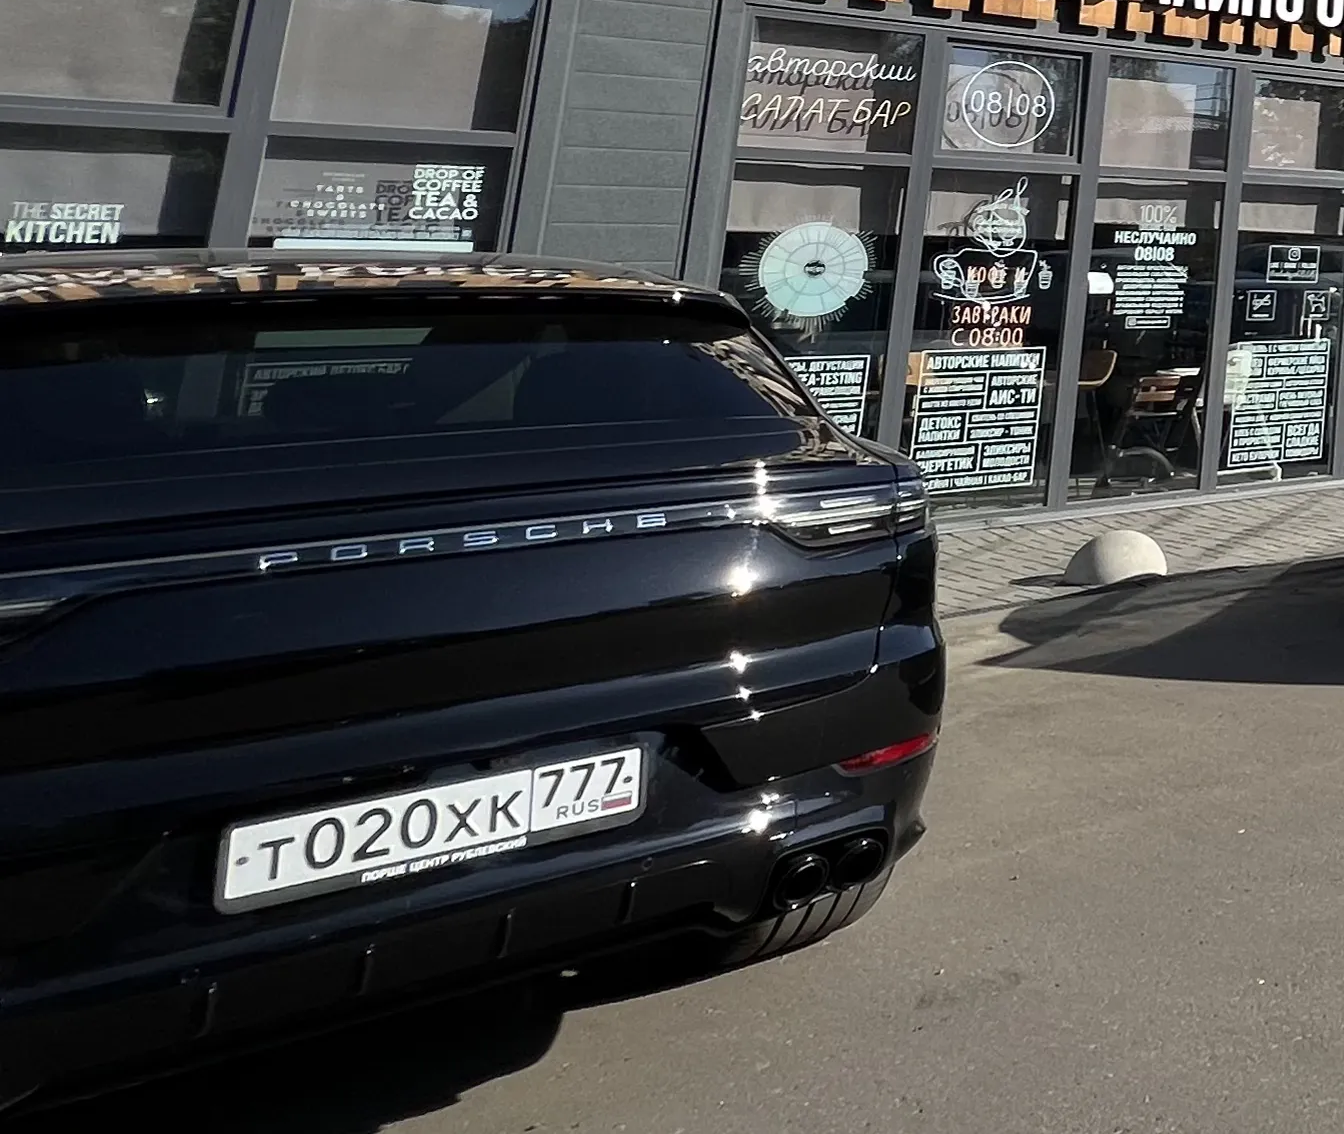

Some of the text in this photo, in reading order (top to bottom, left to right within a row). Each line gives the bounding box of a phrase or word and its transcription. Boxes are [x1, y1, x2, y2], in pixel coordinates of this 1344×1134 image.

[740, 91, 913, 129] САЛАТ БАР
[414, 168, 485, 181] DROP OF
[411, 178, 484, 193] COFFEE
[411, 190, 479, 208] TEA &
[12, 201, 125, 221] THE SECRET
[408, 207, 479, 221] CACAO
[1140, 204, 1178, 224] 100%
[4, 219, 121, 245] KITCHEN
[951, 305, 1032, 325] ЗАВТРАКИ
[951, 327, 1024, 347] С 08:00
[927, 352, 1041, 370] АВТОРСКИЕ НАПИТКИ
[990, 373, 1038, 387] АВТОРСКИЕ
[920, 415, 962, 431] ДЕТОКС
[917, 429, 961, 443] НАПИТКИ
[983, 441, 1032, 456] ЭЛИКСИРЫ
[257, 511, 667, 572] PORSCHE
[256, 756, 628, 881] Т020ХК 777
[555, 797, 599, 820] RUS
[360, 862, 408, 884] ПОРШЕ
[408, 852, 450, 874] ЦЕНТР
